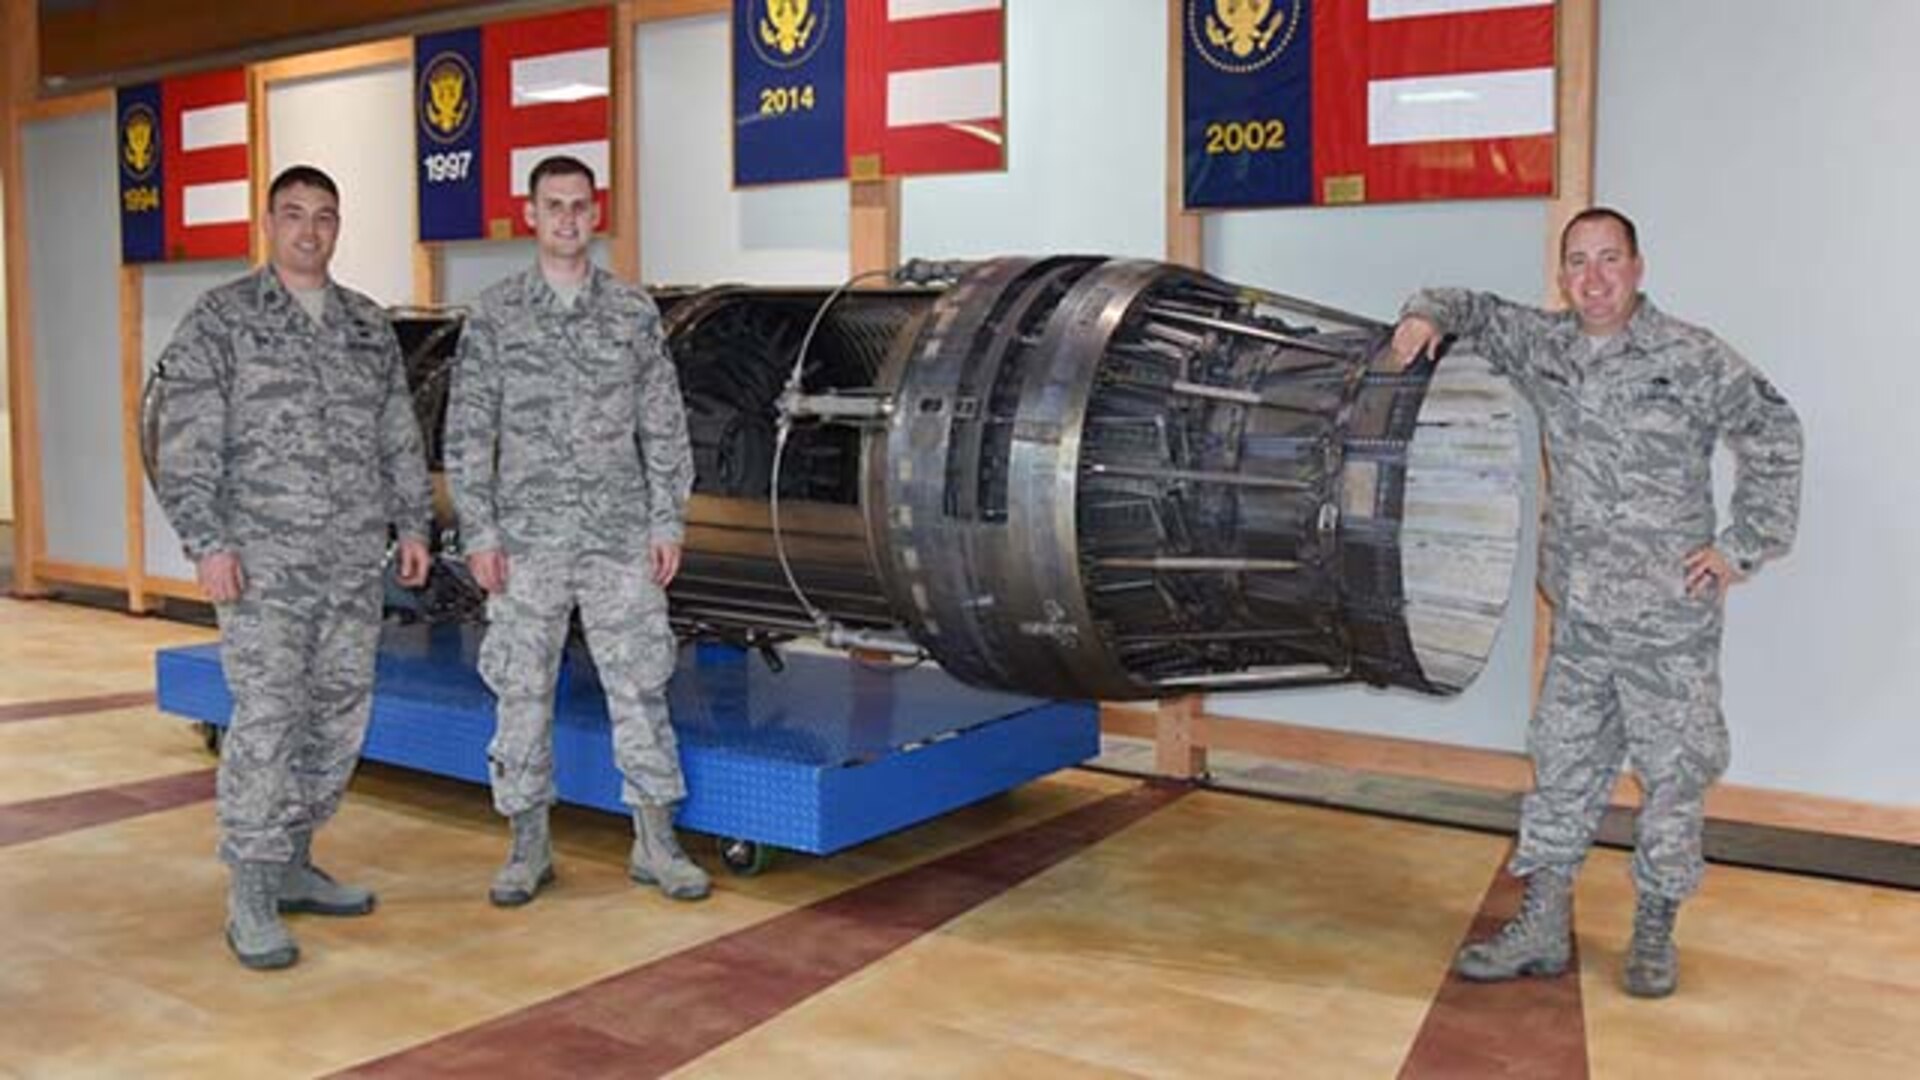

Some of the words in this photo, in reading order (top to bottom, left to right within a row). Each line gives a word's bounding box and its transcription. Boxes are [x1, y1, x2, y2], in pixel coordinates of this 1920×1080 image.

[760, 85, 814, 116] 2014
[1206, 120, 1285, 154] 2002
[423, 151, 472, 182] 1997
